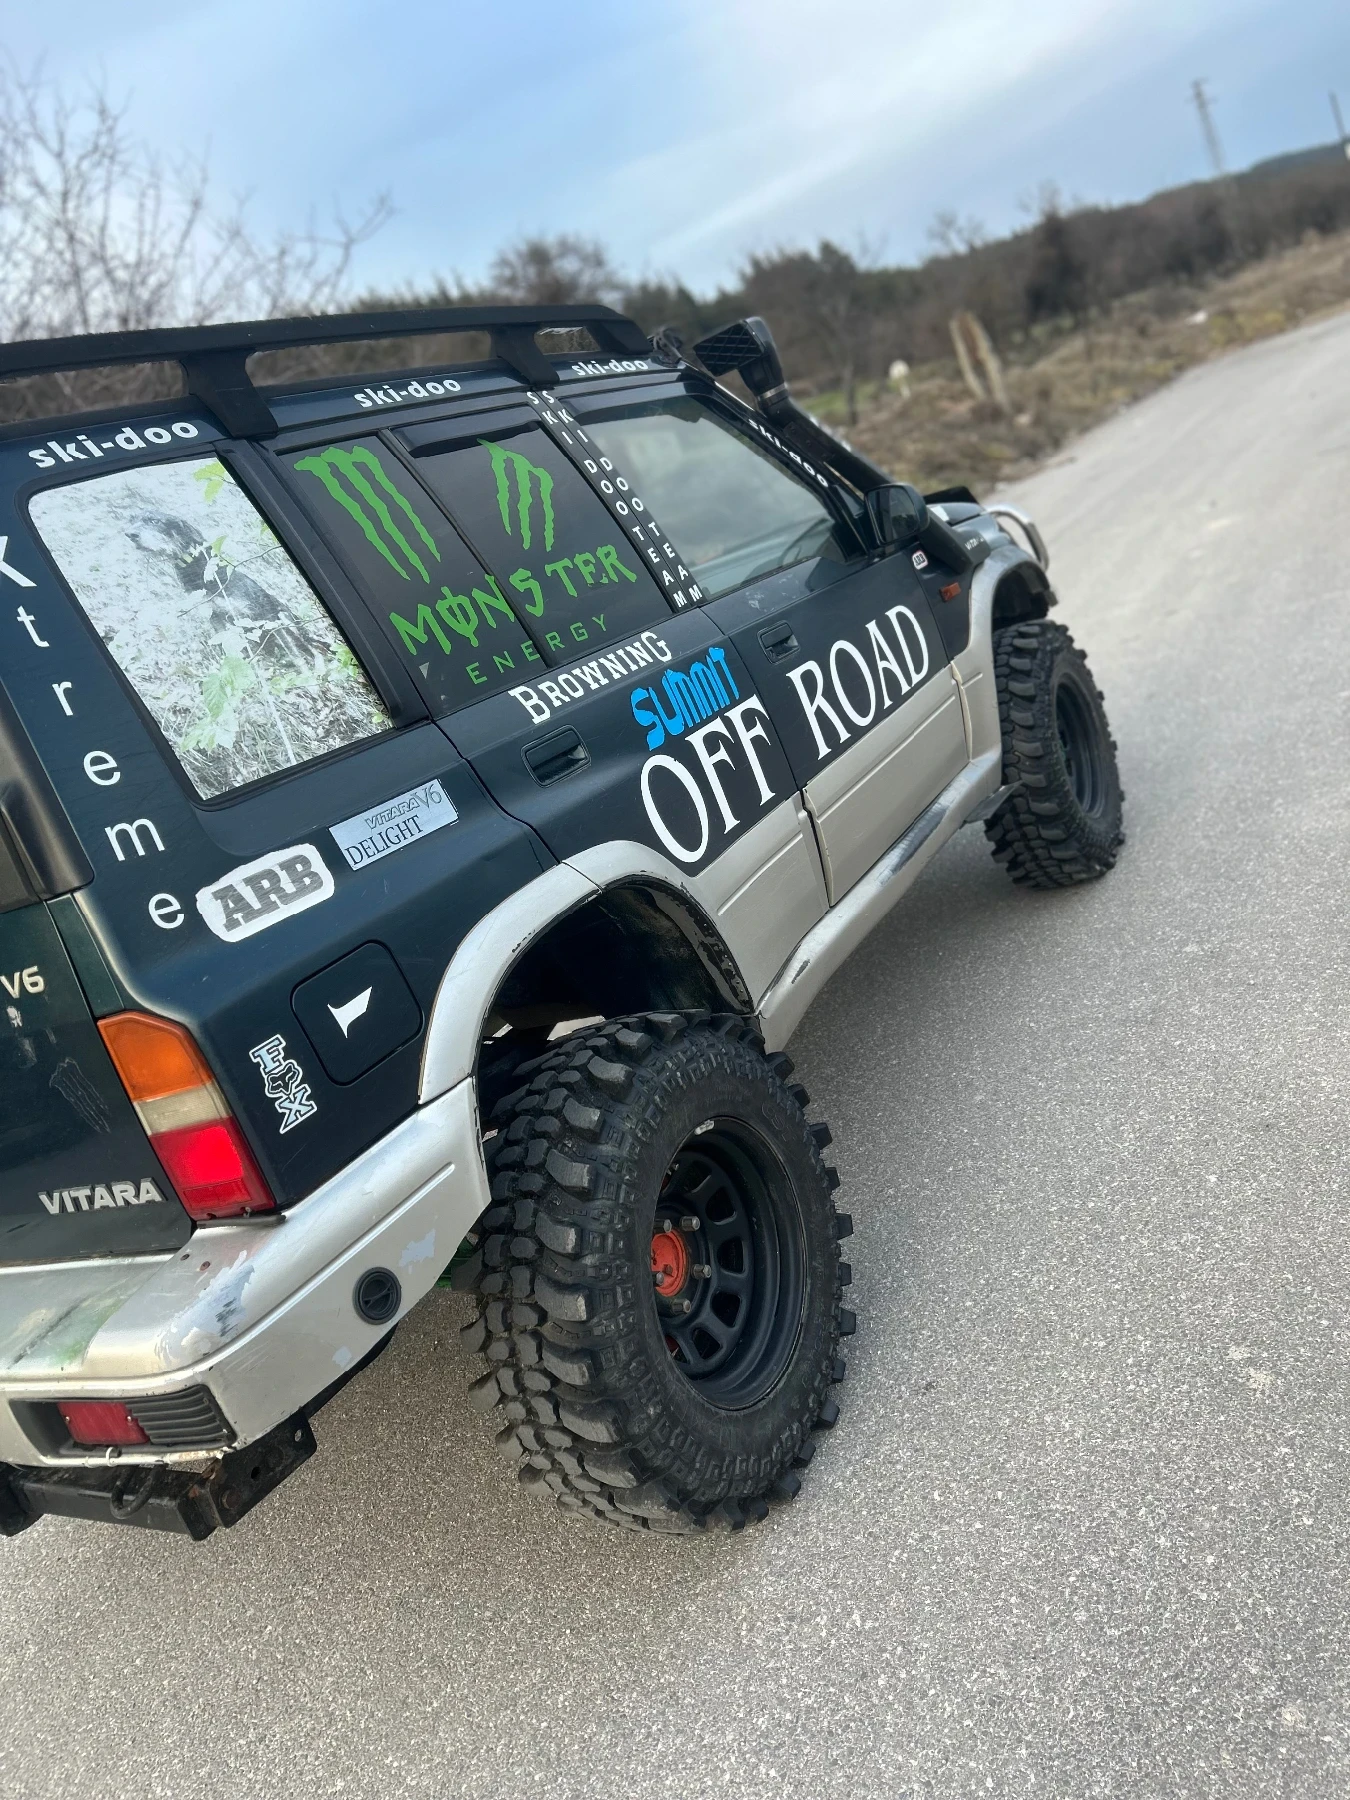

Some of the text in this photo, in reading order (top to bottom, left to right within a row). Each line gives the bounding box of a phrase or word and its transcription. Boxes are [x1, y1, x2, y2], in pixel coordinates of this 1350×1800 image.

[353, 378, 462, 409] ski-doo
[571, 358, 650, 377] ski-doo
[28, 421, 199, 469] ski-doo
[748, 418, 829, 488] ski-doo
[465, 613, 608, 685] ENERGY
[508, 630, 673, 725] BROWNING
[630, 646, 740, 751] SUMMIT
[640, 604, 929, 863] OFF ROAD
[364, 797, 421, 830] VITARA
[345, 814, 424, 866] DELIGHT
[211, 854, 325, 933] ARB
[0, 965, 45, 999] V6
[39, 1177, 166, 1216] VITARA
